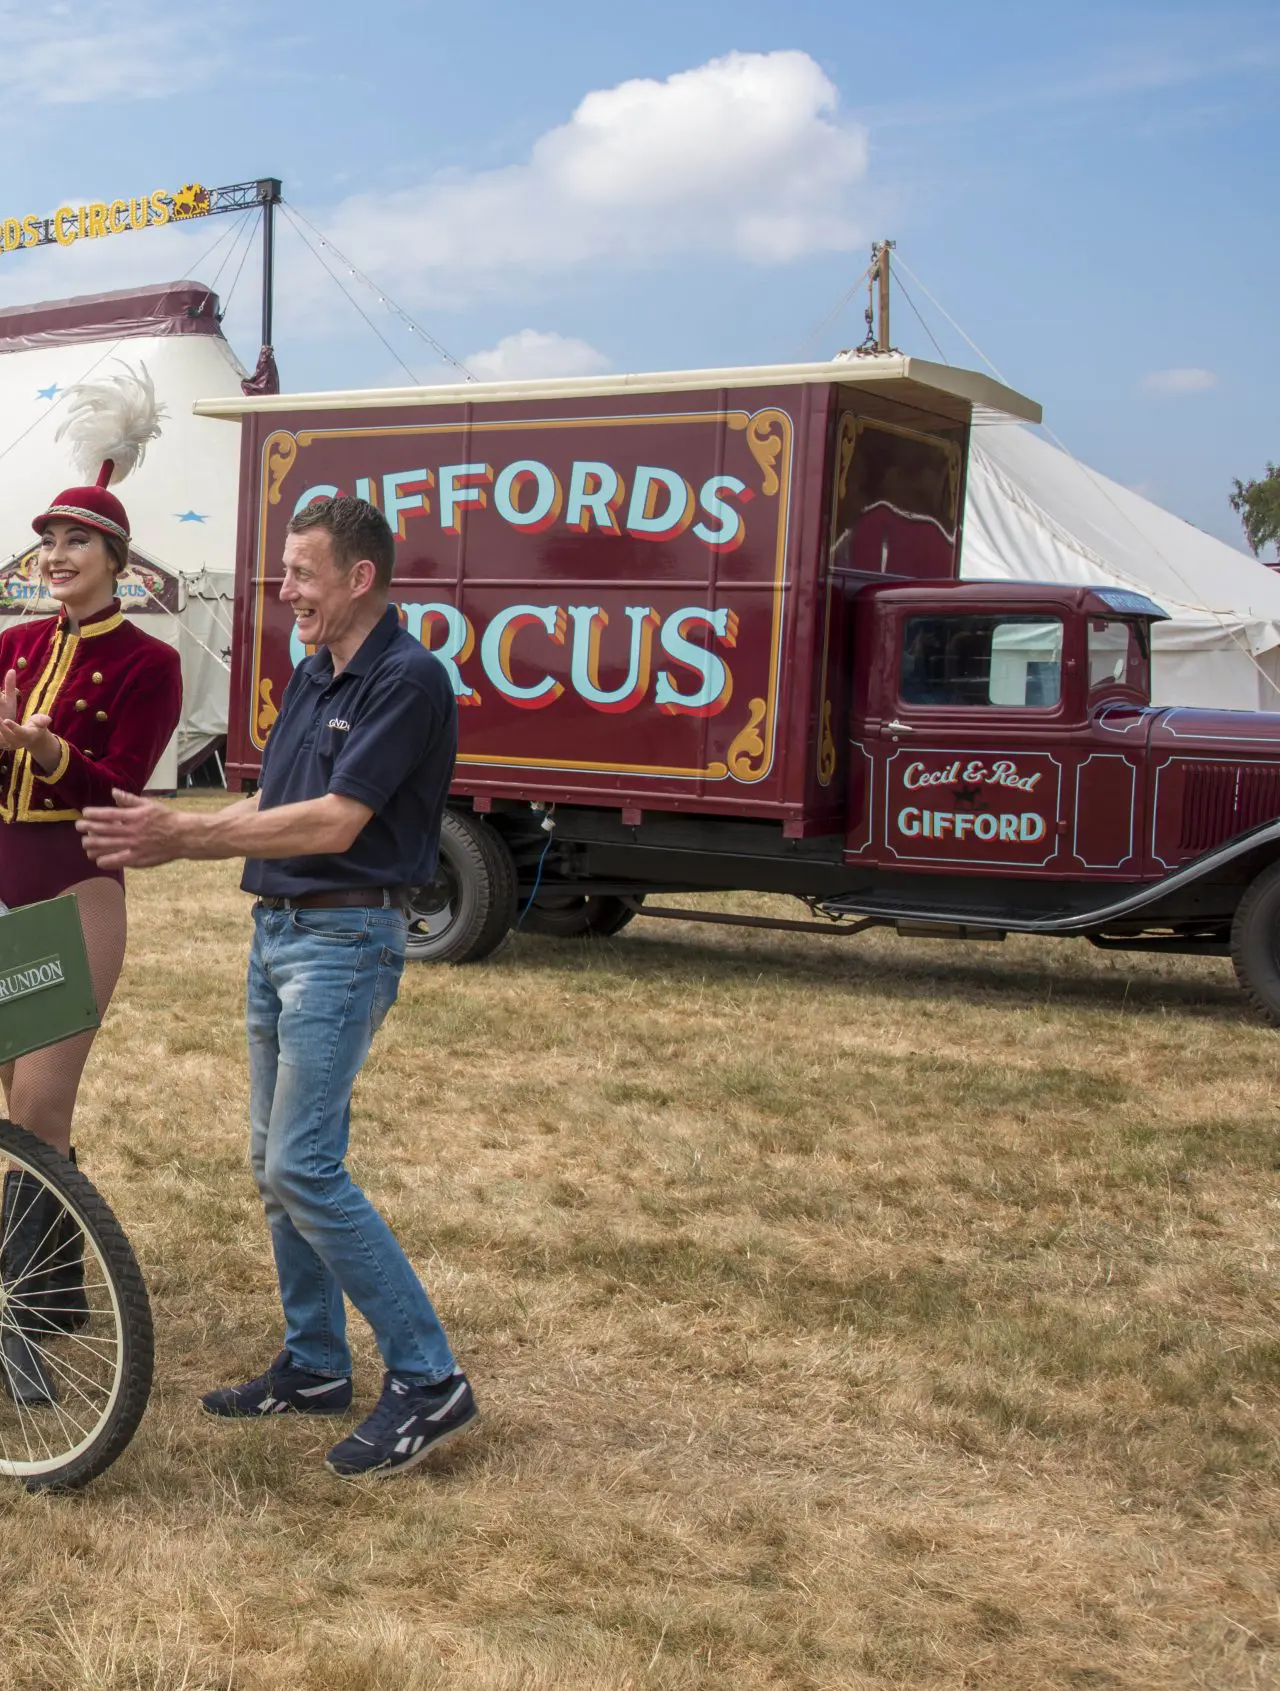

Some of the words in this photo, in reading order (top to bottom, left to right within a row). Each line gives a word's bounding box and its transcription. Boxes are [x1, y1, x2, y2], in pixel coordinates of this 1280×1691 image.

[54, 189, 170, 247] CIRCUS
[290, 602, 737, 713] RCUS
[903, 761, 961, 791] Cecil
[962, 760, 988, 783] &
[985, 760, 1042, 792] Red
[897, 806, 1047, 843] GIFFORD
